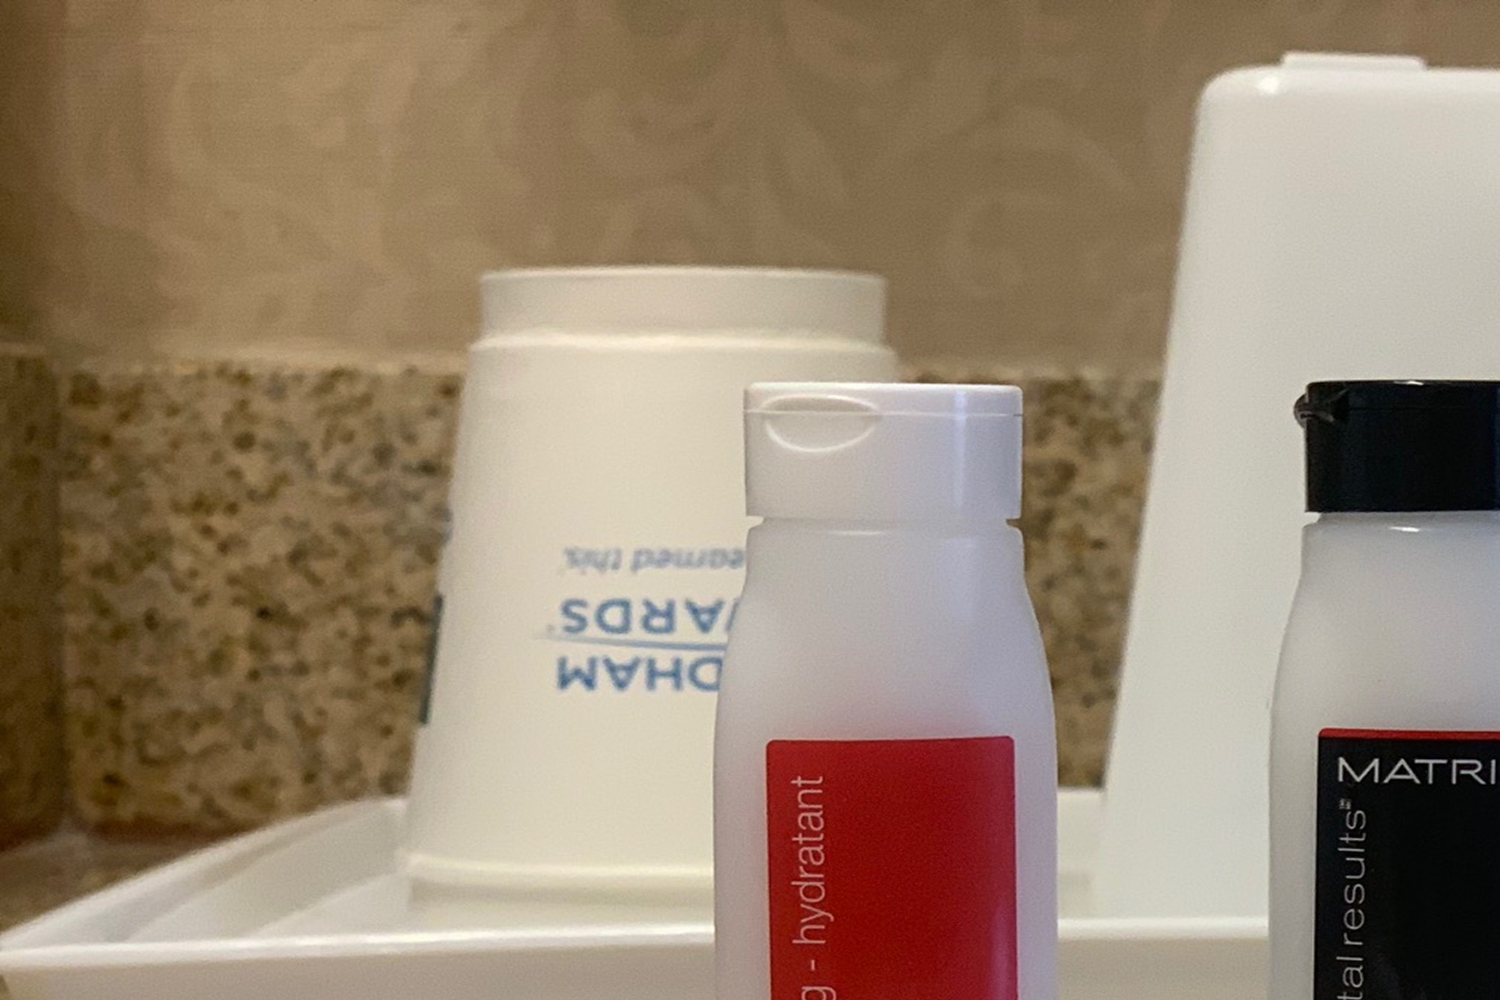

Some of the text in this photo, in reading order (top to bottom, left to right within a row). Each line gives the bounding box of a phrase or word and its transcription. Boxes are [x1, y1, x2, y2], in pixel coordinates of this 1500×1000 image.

[559, 598, 738, 634] ARDS
[556, 655, 724, 692] DHAM
[790, 775, 835, 946] hydratant
